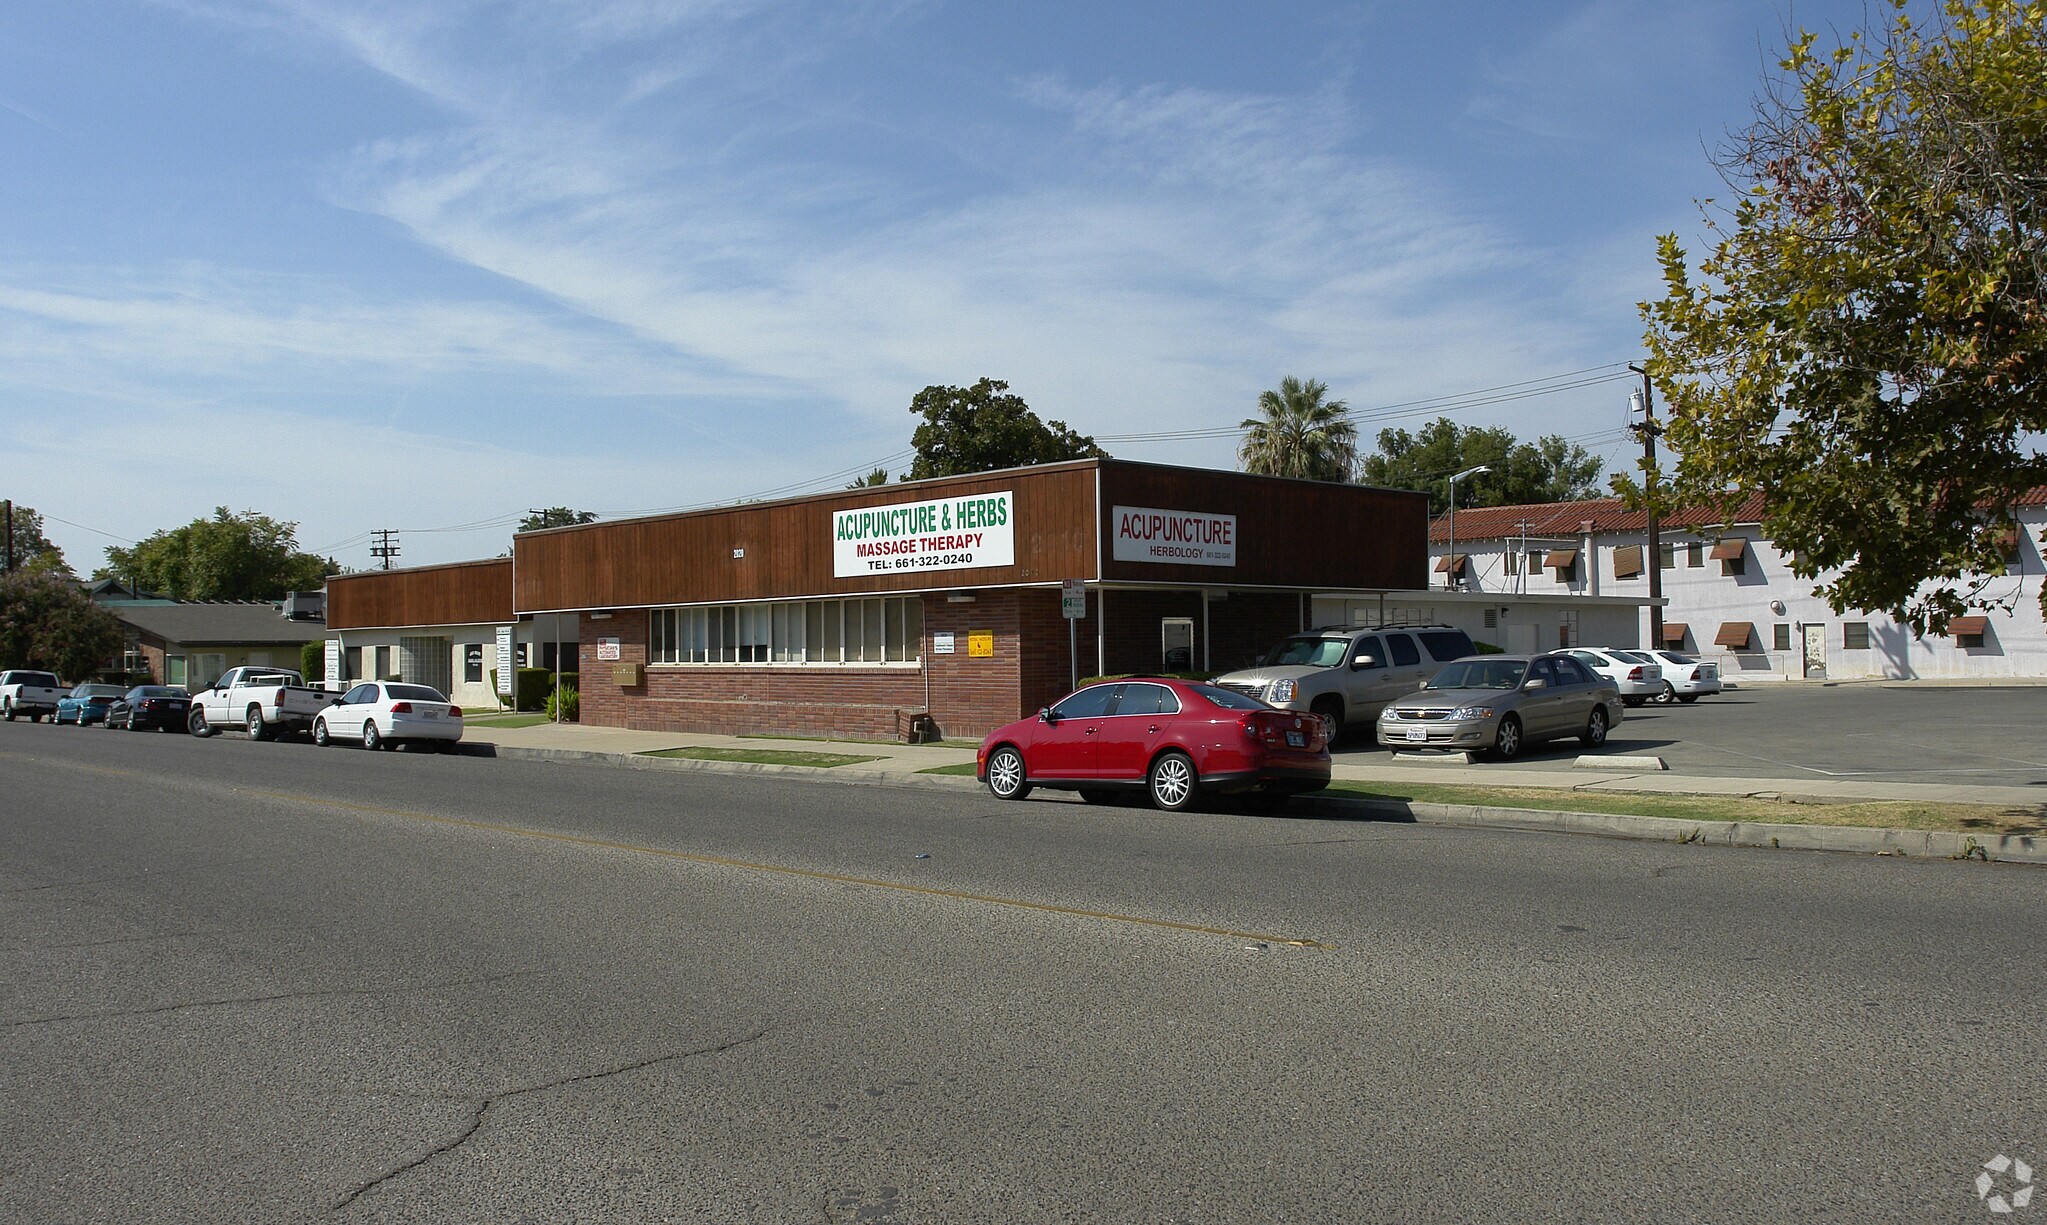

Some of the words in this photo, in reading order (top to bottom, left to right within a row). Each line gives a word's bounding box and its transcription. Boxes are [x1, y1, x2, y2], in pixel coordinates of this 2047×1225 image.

[837, 505, 936, 541] ACUPUNCTURE
[941, 503, 952, 531] &
[956, 497, 1007, 530] HERBS
[1120, 513, 1231, 545] ACUPUNCTURE
[856, 539, 917, 558] MASSAGE
[919, 533, 983, 552] THERAPY
[1150, 545, 1204, 559] HERBOLOGY
[868, 560, 892, 571] TEL:
[895, 553, 973, 569] 661-322-0240
